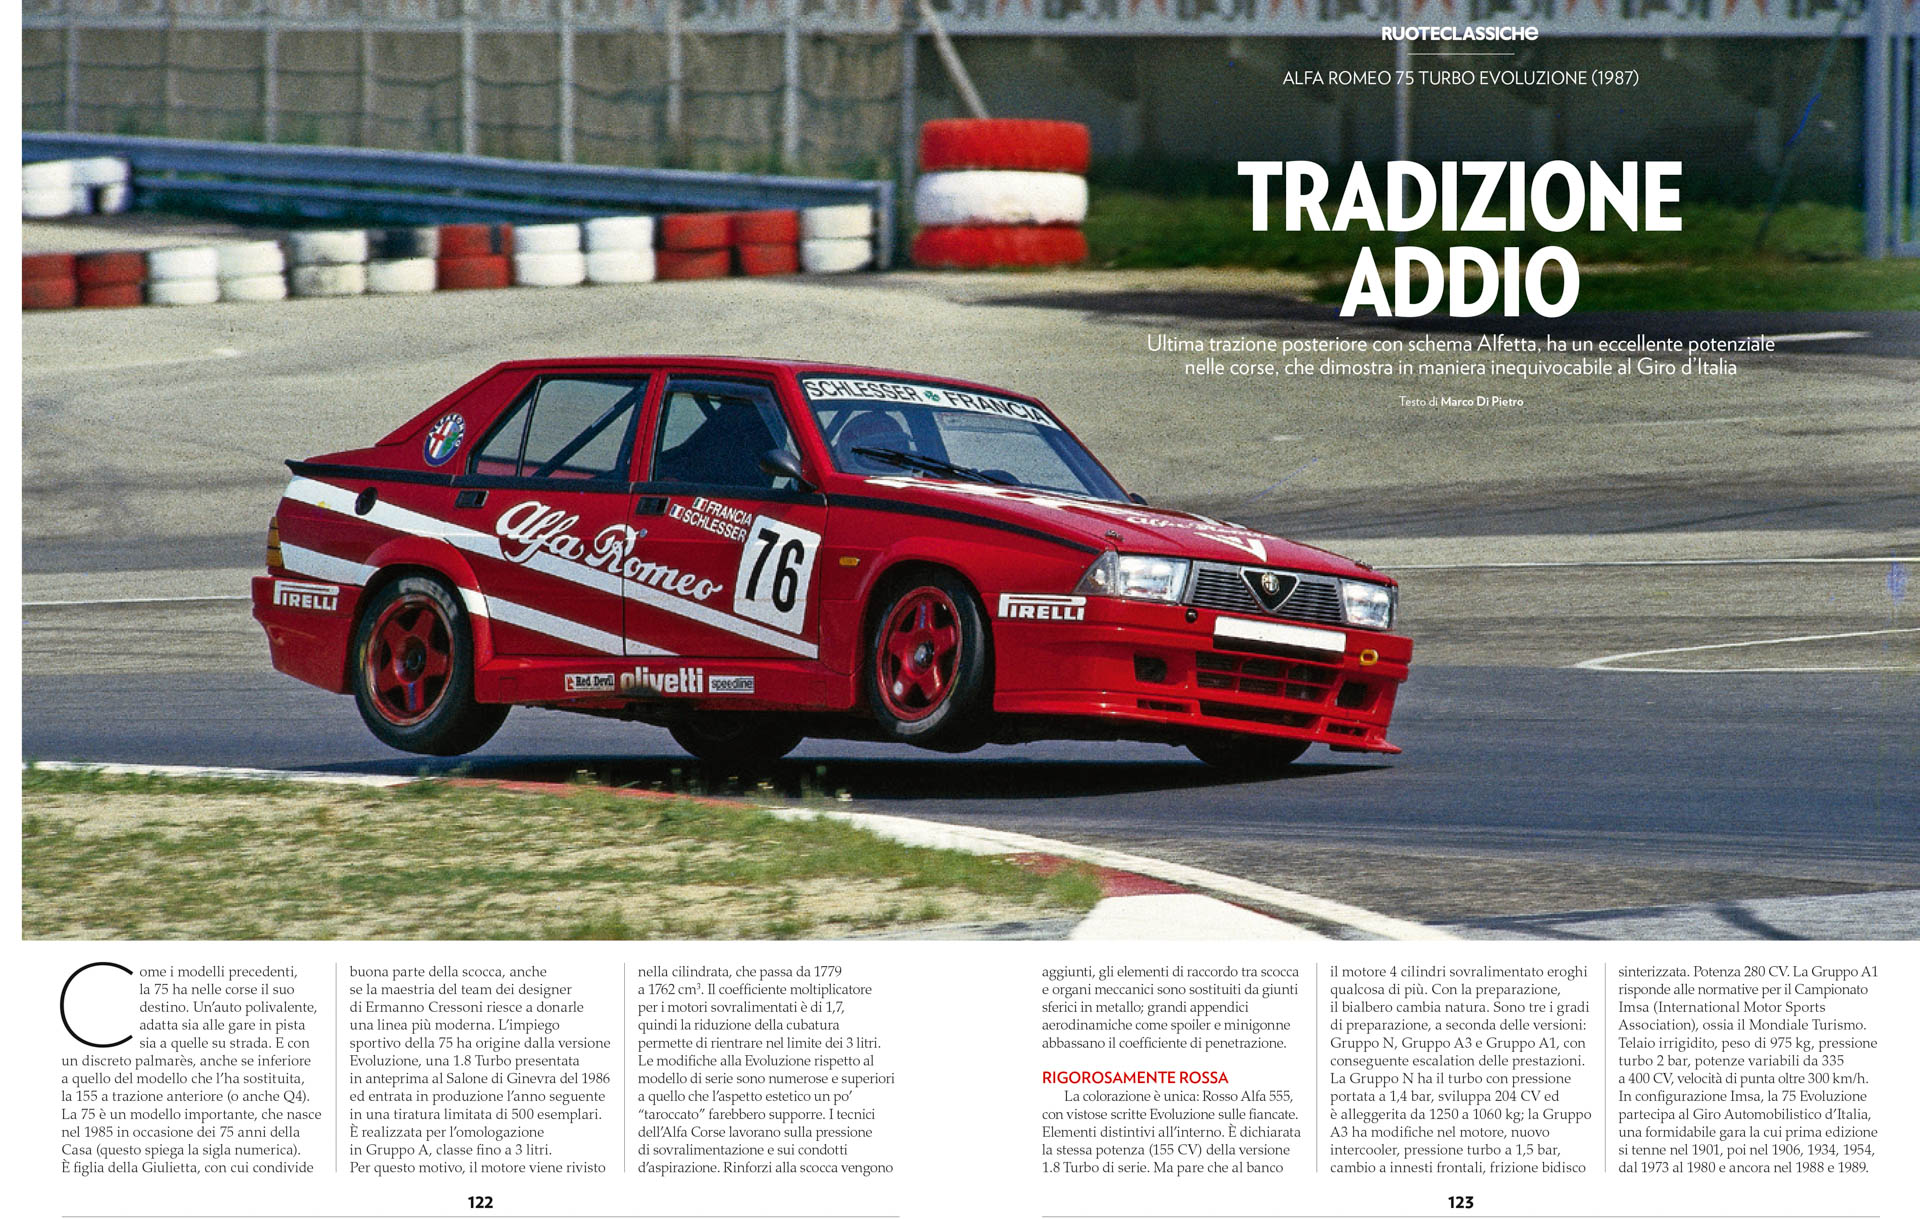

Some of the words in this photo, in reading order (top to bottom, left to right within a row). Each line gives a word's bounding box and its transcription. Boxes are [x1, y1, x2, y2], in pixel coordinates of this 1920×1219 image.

[805, 379, 923, 402] SCHLESSER
[943, 390, 1047, 424] FRANCIA
[706, 500, 754, 526] FRANCIA
[682, 509, 747, 543] SCHLESSER
[495, 500, 584, 563] Alfa
[586, 522, 724, 601] Romeo
[745, 527, 806, 614] 76
[273, 580, 340, 611] PIRELLI
[998, 593, 1087, 621] PIRELLI
[620, 666, 703, 693] olivetti
[711, 677, 754, 690] speedline
[169, 965, 175, 978] i
[177, 965, 225, 978] modelli
[228, 965, 298, 981] precedenti,
[349, 965, 389, 978] buona
[392, 967, 426, 981] parte
[428, 965, 459, 978] della
[461, 968, 506, 979] scocca,
[509, 965, 548, 978] anche
[638, 965, 669, 978] nella
[671, 965, 733, 980] cilindrata,
[735, 965, 757, 978] che
[759, 968, 793, 981] passa
[795, 965, 811, 978] da
[814, 965, 842, 978] 1779
[1329, 983, 1386, 999] qualcosa
[1387, 983, 1401, 995] di
[1404, 982, 1428, 999] più.
[1431, 983, 1458, 995] Con
[1460, 983, 1473, 995] la
[1475, 983, 1561, 999] preparazione,
[139, 1000, 189, 1013] destino.
[244, 1000, 318, 1017] polivalente,
[1041, 1000, 1078, 1013] sferici
[1079, 1000, 1094, 1013] in
[1095, 1000, 1145, 1015] metallo;
[1146, 1000, 1188, 1017] grandi
[1189, 1000, 1249, 1017] appendici
[1618, 1000, 1650, 1013] Imsa
[1653, 1000, 1741, 1015] (International
[1743, 1000, 1783, 1013] Motor
[1785, 1000, 1826, 1017] Sports
[349, 1021, 374, 1031] una
[377, 1018, 408, 1031] linea
[411, 1018, 432, 1034] più
[435, 1018, 495, 1031] moderna.
[637, 1018, 678, 1034] quindi
[680, 1018, 692, 1031] la
[694, 1018, 752, 1031] riduzione
[754, 1018, 784, 1031] della
[786, 1018, 840, 1031] cubatura
[1617, 1018, 1699, 1033] Association),
[1702, 1018, 1735, 1031] ossia
[1736, 1018, 1746, 1031] il
[1748, 1018, 1809, 1031] Mondiale
[1811, 1018, 1867, 1031] Turismo.
[1041, 1036, 1106, 1049] abbassano
[1108, 1036, 1117, 1049] il
[1118, 1036, 1188, 1049] coefficiente
[1189, 1036, 1203, 1049] di
[1204, 1036, 1287, 1052] penetrazione.
[61, 1057, 78, 1067] un
[81, 1054, 132, 1067] discreto
[135, 1054, 196, 1070] palmarès,
[199, 1054, 238, 1067] anche
[240, 1057, 255, 1067] se
[257, 1054, 312, 1067] inferiore
[349, 1054, 422, 1068] Evoluzione,
[425, 1057, 450, 1067] una
[453, 1054, 472, 1067] 1.8
[474, 1054, 512, 1067] Turbo
[514, 1056, 580, 1070] presentata
[1329, 1056, 1410, 1070] conseguente
[1412, 1054, 1476, 1067] escalation
[1478, 1054, 1509, 1067] delle
[1511, 1054, 1585, 1070] prestazioni.
[1042, 1070, 1176, 1085] RIGOROSAMENTE
[1179, 1070, 1230, 1085] ROSSA
[1618, 1108, 1676, 1123] partecipa
[1678, 1107, 1690, 1120] al
[1692, 1108, 1722, 1120] Giro
[1723, 1107, 1823, 1120] Automobilistico
[690, 1125, 726, 1138] Corse
[728, 1125, 781, 1138] lavorano
[783, 1125, 813, 1138] sulla
[815, 1125, 873, 1141] pressione
[1042, 1125, 1097, 1138] Elementi
[1099, 1125, 1156, 1138] distintivi
[1228, 1122, 1237, 1138] È
[1239, 1125, 1302, 1138] dichiarata
[61, 1143, 93, 1156] Casa
[96, 1143, 142, 1159] (questo
[144, 1143, 185, 1159] spiega
[187, 1143, 200, 1156] la
[202, 1143, 232, 1159] sigla
[234, 1143, 301, 1158] numerica).
[1329, 1161, 1377, 1174] cambio
[1378, 1164, 1387, 1174] a
[1389, 1161, 1433, 1174] innesti
[1436, 1160, 1487, 1176] frontali,
[1489, 1160, 1539, 1174] frizione
[1541, 1160, 1587, 1174] bidisco
[467, 1195, 494, 1209] 122
[1447, 1195, 1474, 1209] 123
